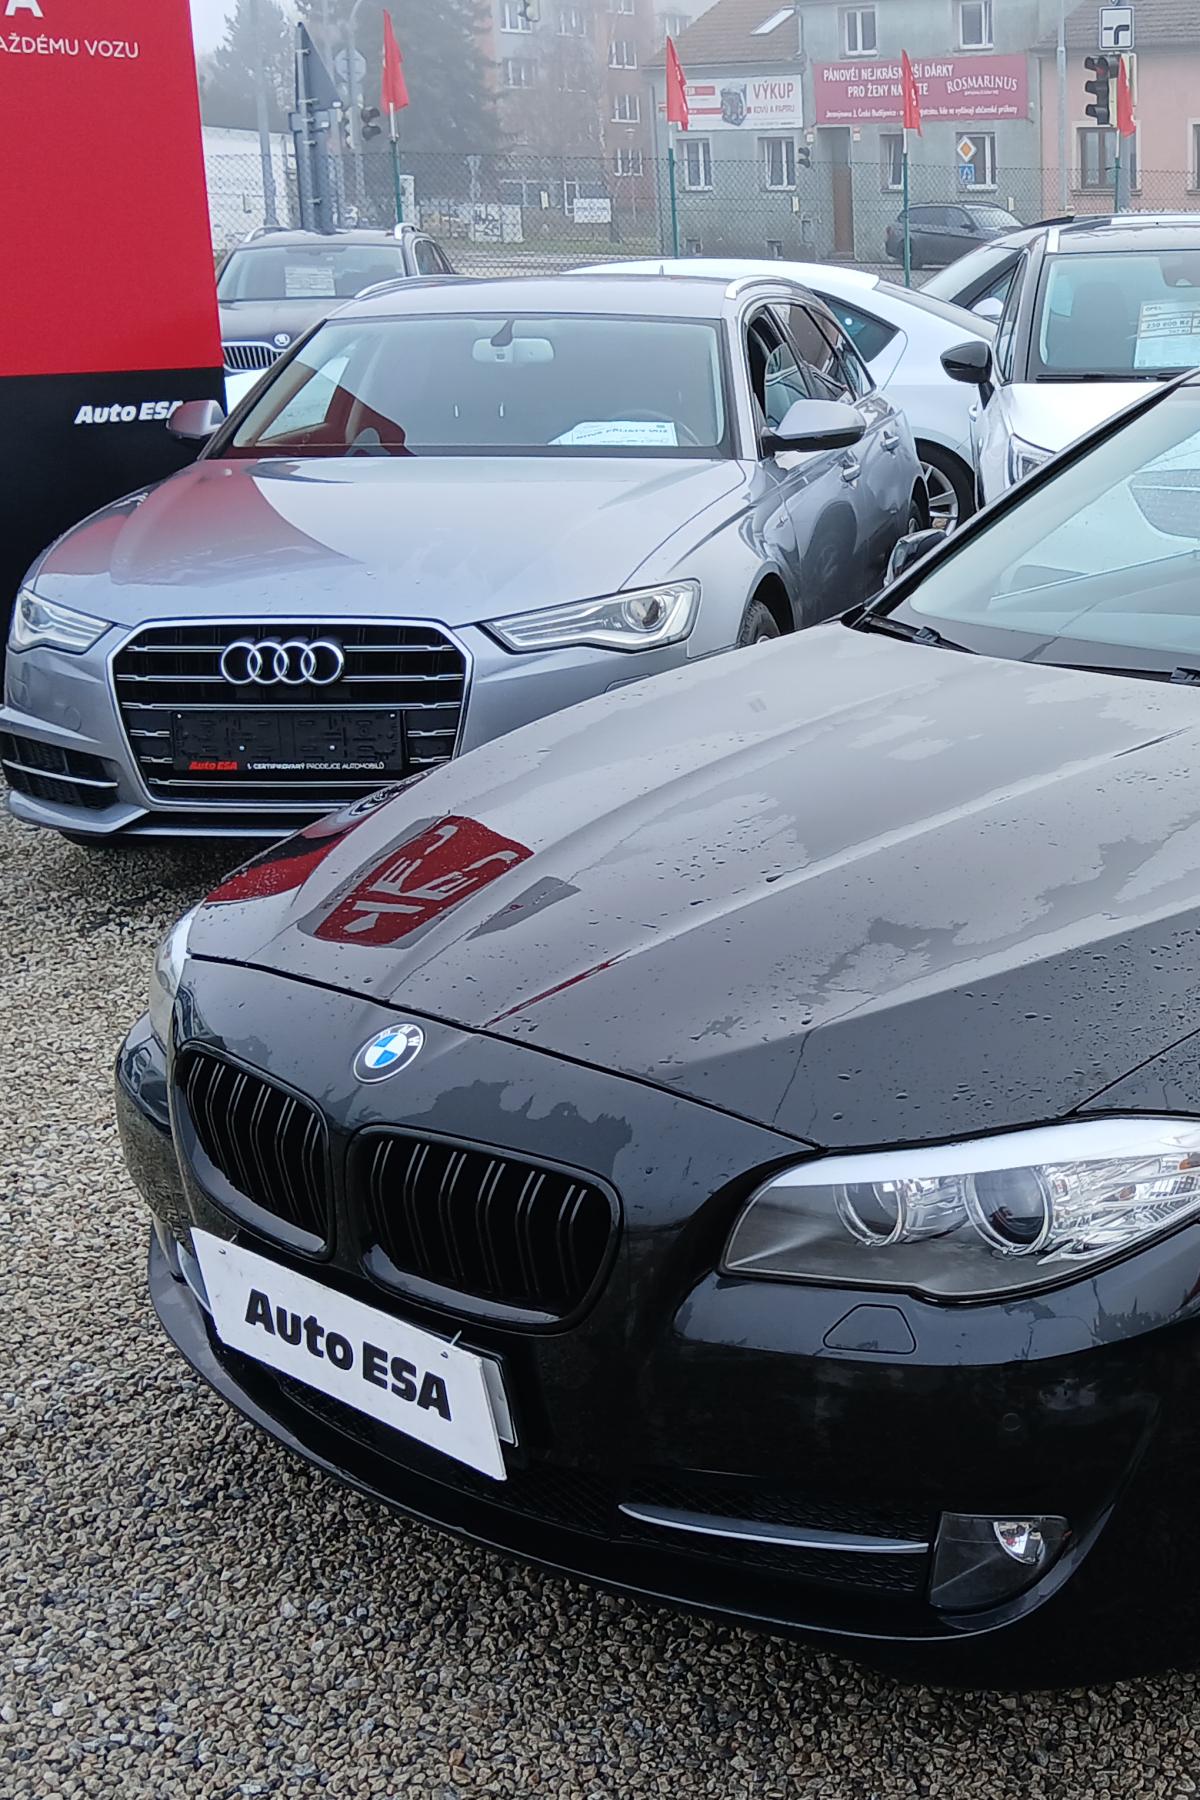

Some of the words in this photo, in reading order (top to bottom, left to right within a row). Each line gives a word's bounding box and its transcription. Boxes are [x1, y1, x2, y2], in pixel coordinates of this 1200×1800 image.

[84, 39, 139, 58] VOZU
[924, 62, 954, 77] DÁRKY
[752, 79, 794, 100] VÝKUP
[847, 85, 865, 98] PRO
[867, 82, 889, 97] ŽENY
[946, 74, 1018, 94] ROSMARINUS
[74, 404, 137, 425] Auto
[245, 1288, 354, 1371] Auto
[362, 1340, 452, 1422] ESA
